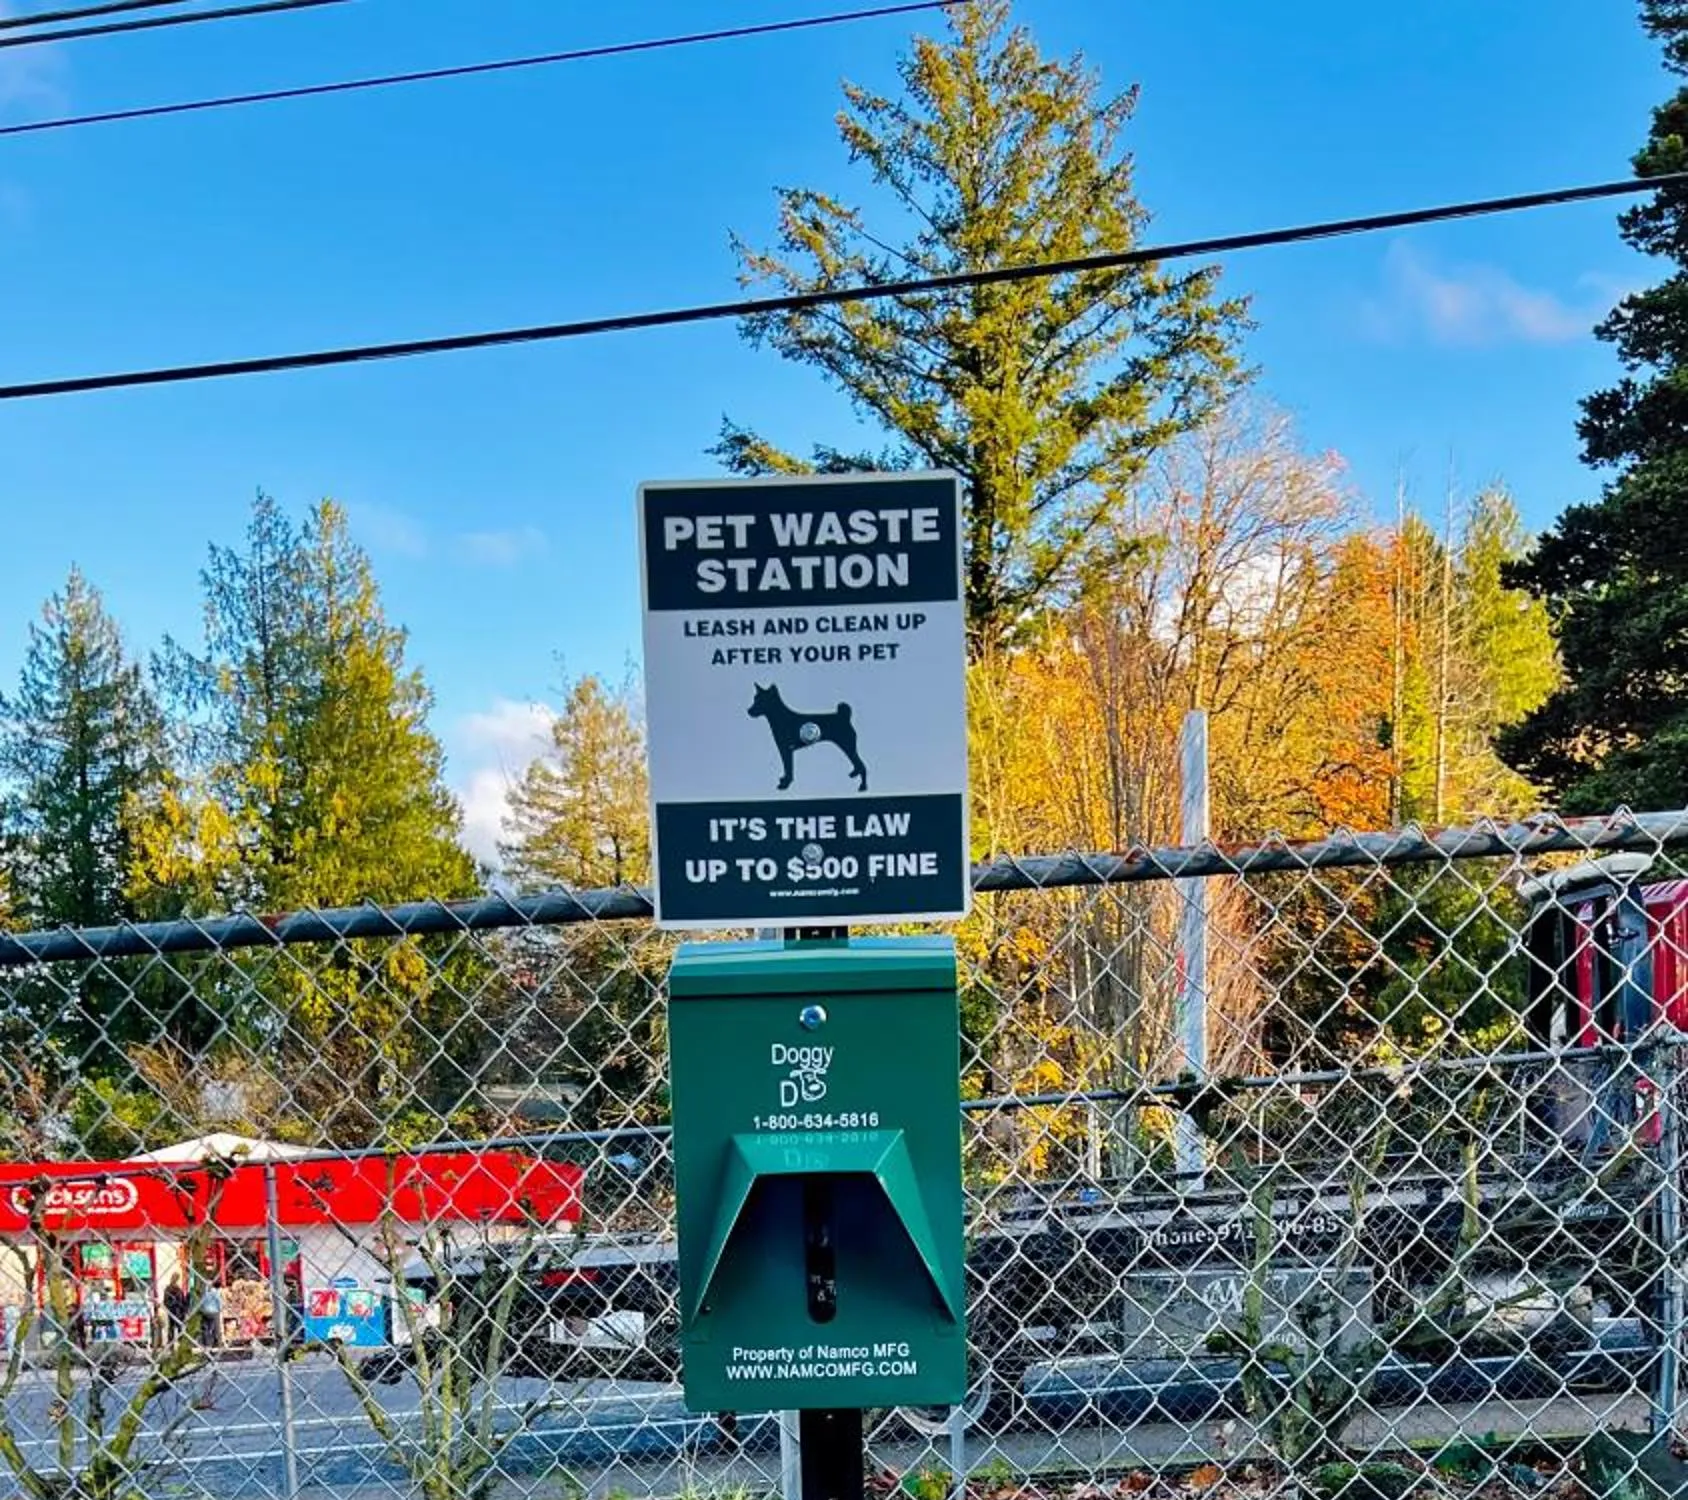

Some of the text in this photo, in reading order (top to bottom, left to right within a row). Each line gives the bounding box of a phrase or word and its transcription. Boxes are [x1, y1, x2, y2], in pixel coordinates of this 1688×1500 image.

[663, 507, 941, 550] PET WASTE
[696, 553, 910, 593] STATION
[683, 612, 927, 637] LEASH AND CLEAN UP
[711, 643, 901, 665] AFTER YOUR PET
[709, 813, 911, 842] IT'S THE LAW
[685, 852, 939, 883] UP TO $500 FINE
[771, 1043, 834, 1070] Doggy
[753, 1111, 880, 1130] 1-800-634-5816
[732, 1342, 911, 1363] Property of Namco MFG
[726, 1360, 918, 1380] WWW.NAMCOMFG.COM
